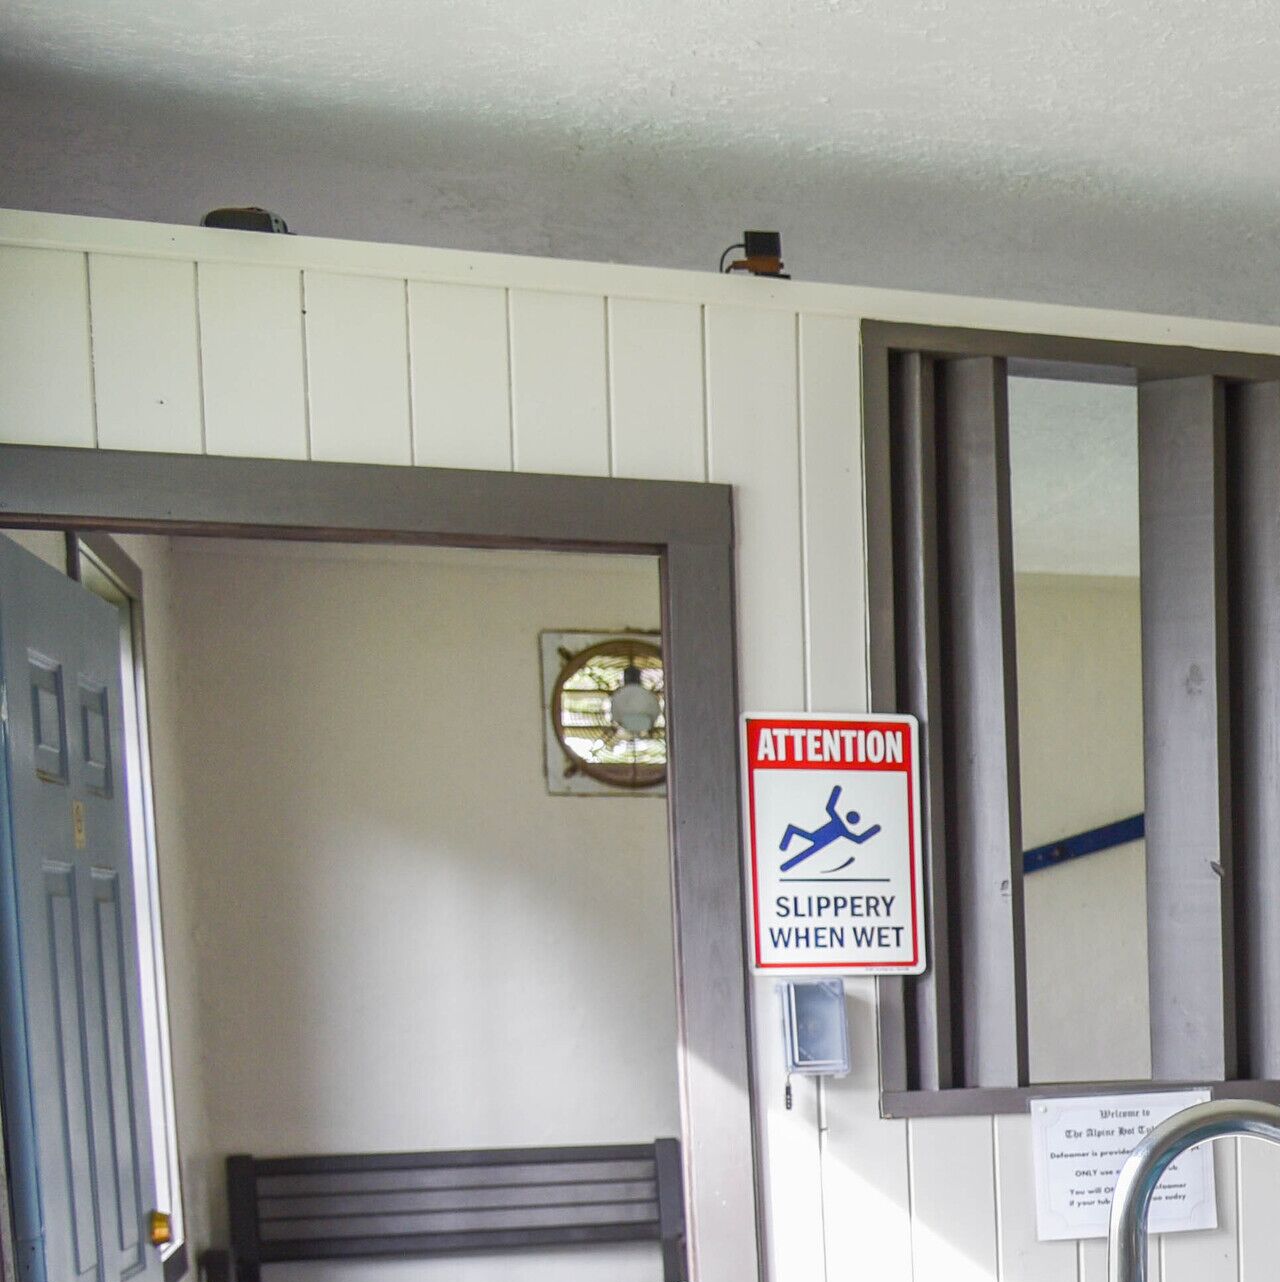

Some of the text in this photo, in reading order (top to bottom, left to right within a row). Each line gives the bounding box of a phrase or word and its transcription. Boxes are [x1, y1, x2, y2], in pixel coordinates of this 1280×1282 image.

[757, 728, 903, 763] ATTENTION
[776, 896, 895, 917] SLIPPERY
[769, 926, 904, 948] WHEN WET
